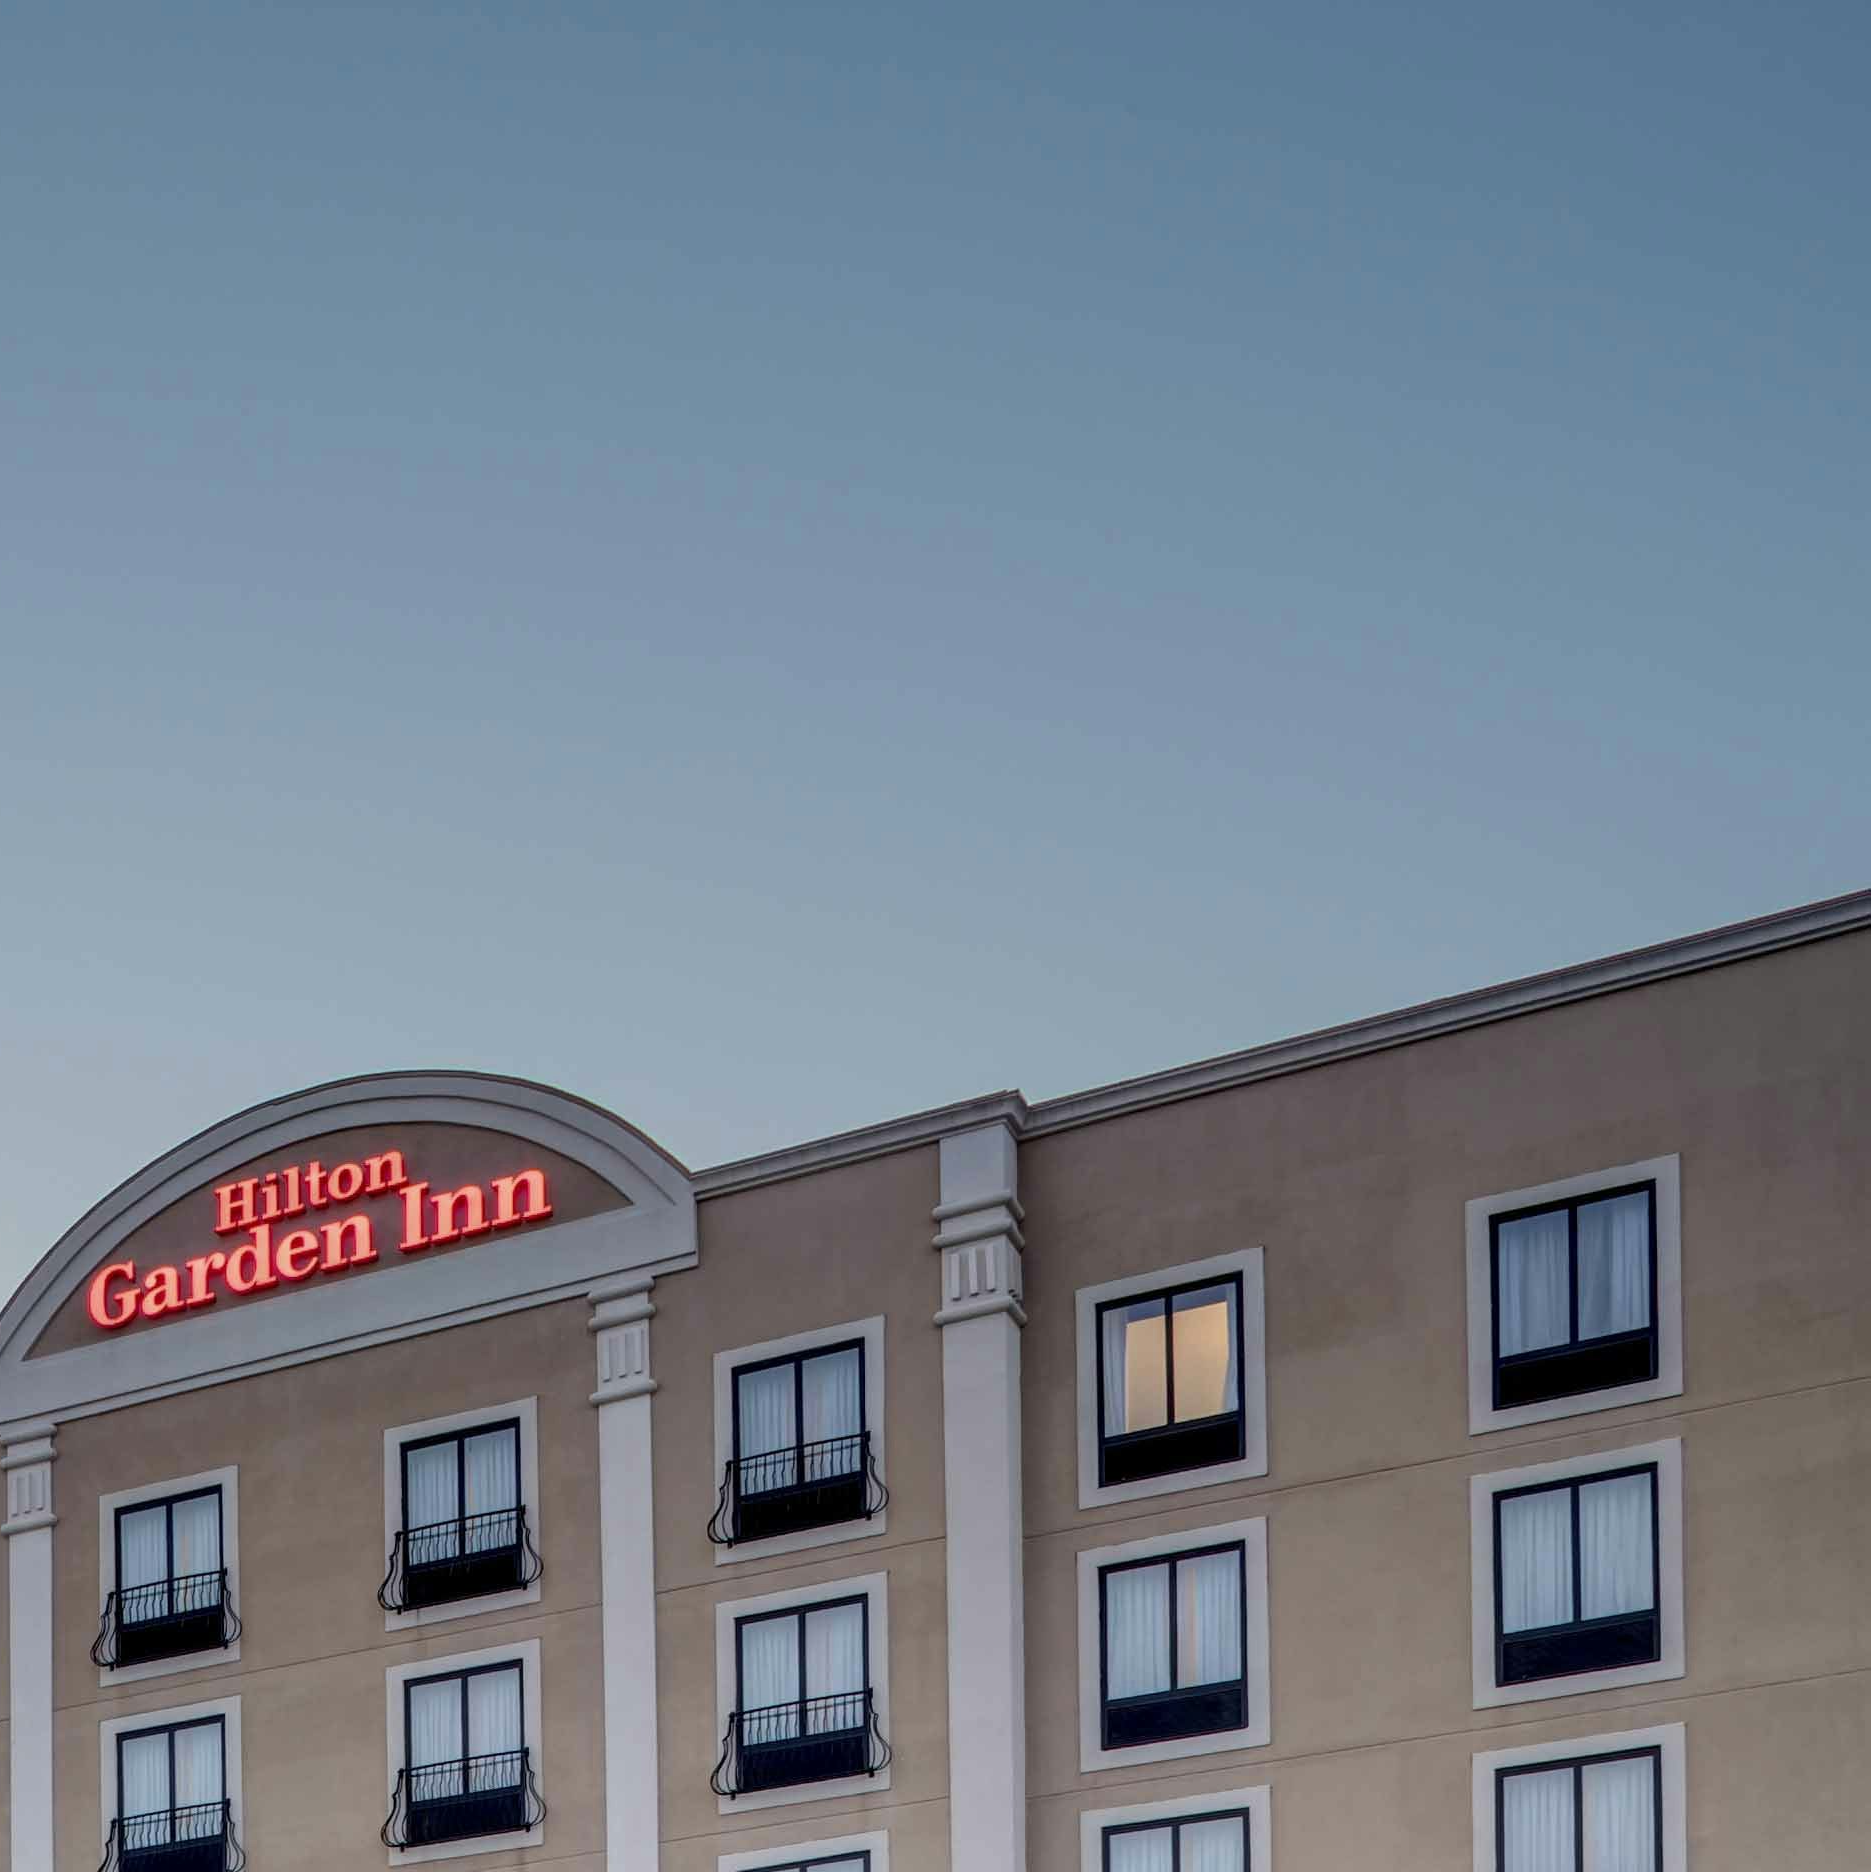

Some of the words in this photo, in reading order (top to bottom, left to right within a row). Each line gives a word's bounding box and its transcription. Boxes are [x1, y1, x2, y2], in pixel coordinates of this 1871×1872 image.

[88, 1212, 378, 1331] Garden
[399, 1167, 554, 1253] Inn
[214, 1149, 409, 1236] Hilton
